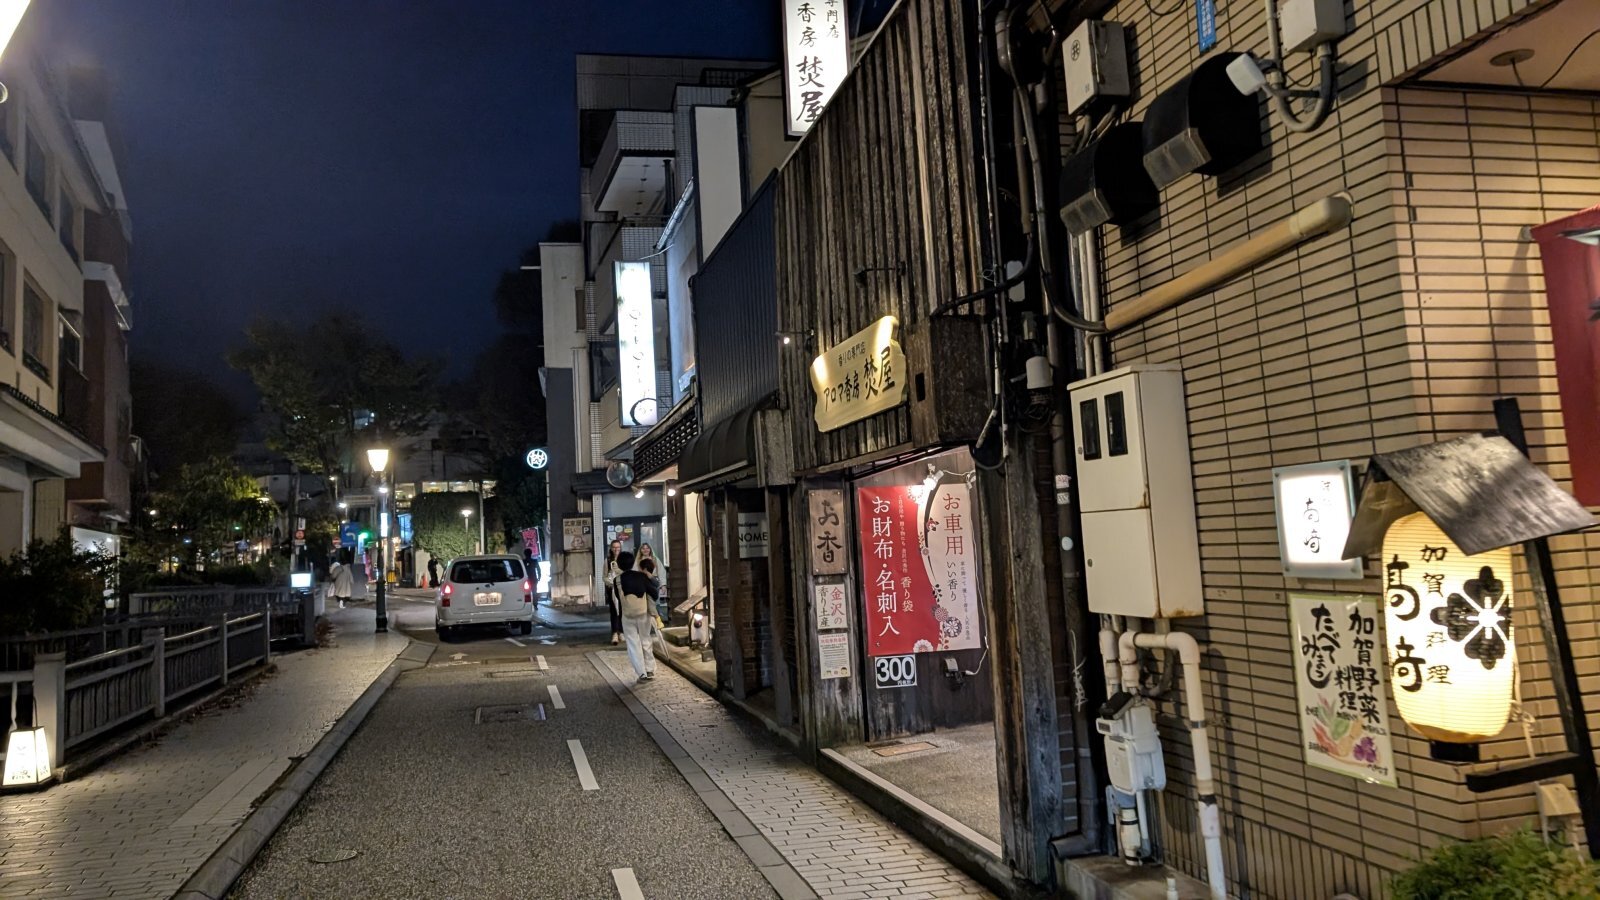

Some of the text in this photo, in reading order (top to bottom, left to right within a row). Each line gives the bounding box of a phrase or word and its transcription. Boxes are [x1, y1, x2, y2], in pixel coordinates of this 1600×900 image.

[797, 2, 817, 48] 香房
[816, 501, 844, 563] お香
[943, 493, 964, 602] お車用 いい香り
[871, 495, 900, 637] お財布・名刺入
[817, 586, 831, 628] 香り土産
[830, 586, 846, 626] 金沢の
[900, 576, 914, 613] 香り袋
[876, 656, 915, 682] 300
[1334, 665, 1358, 711] 料理
[1349, 607, 1380, 724] 加賀野菜
